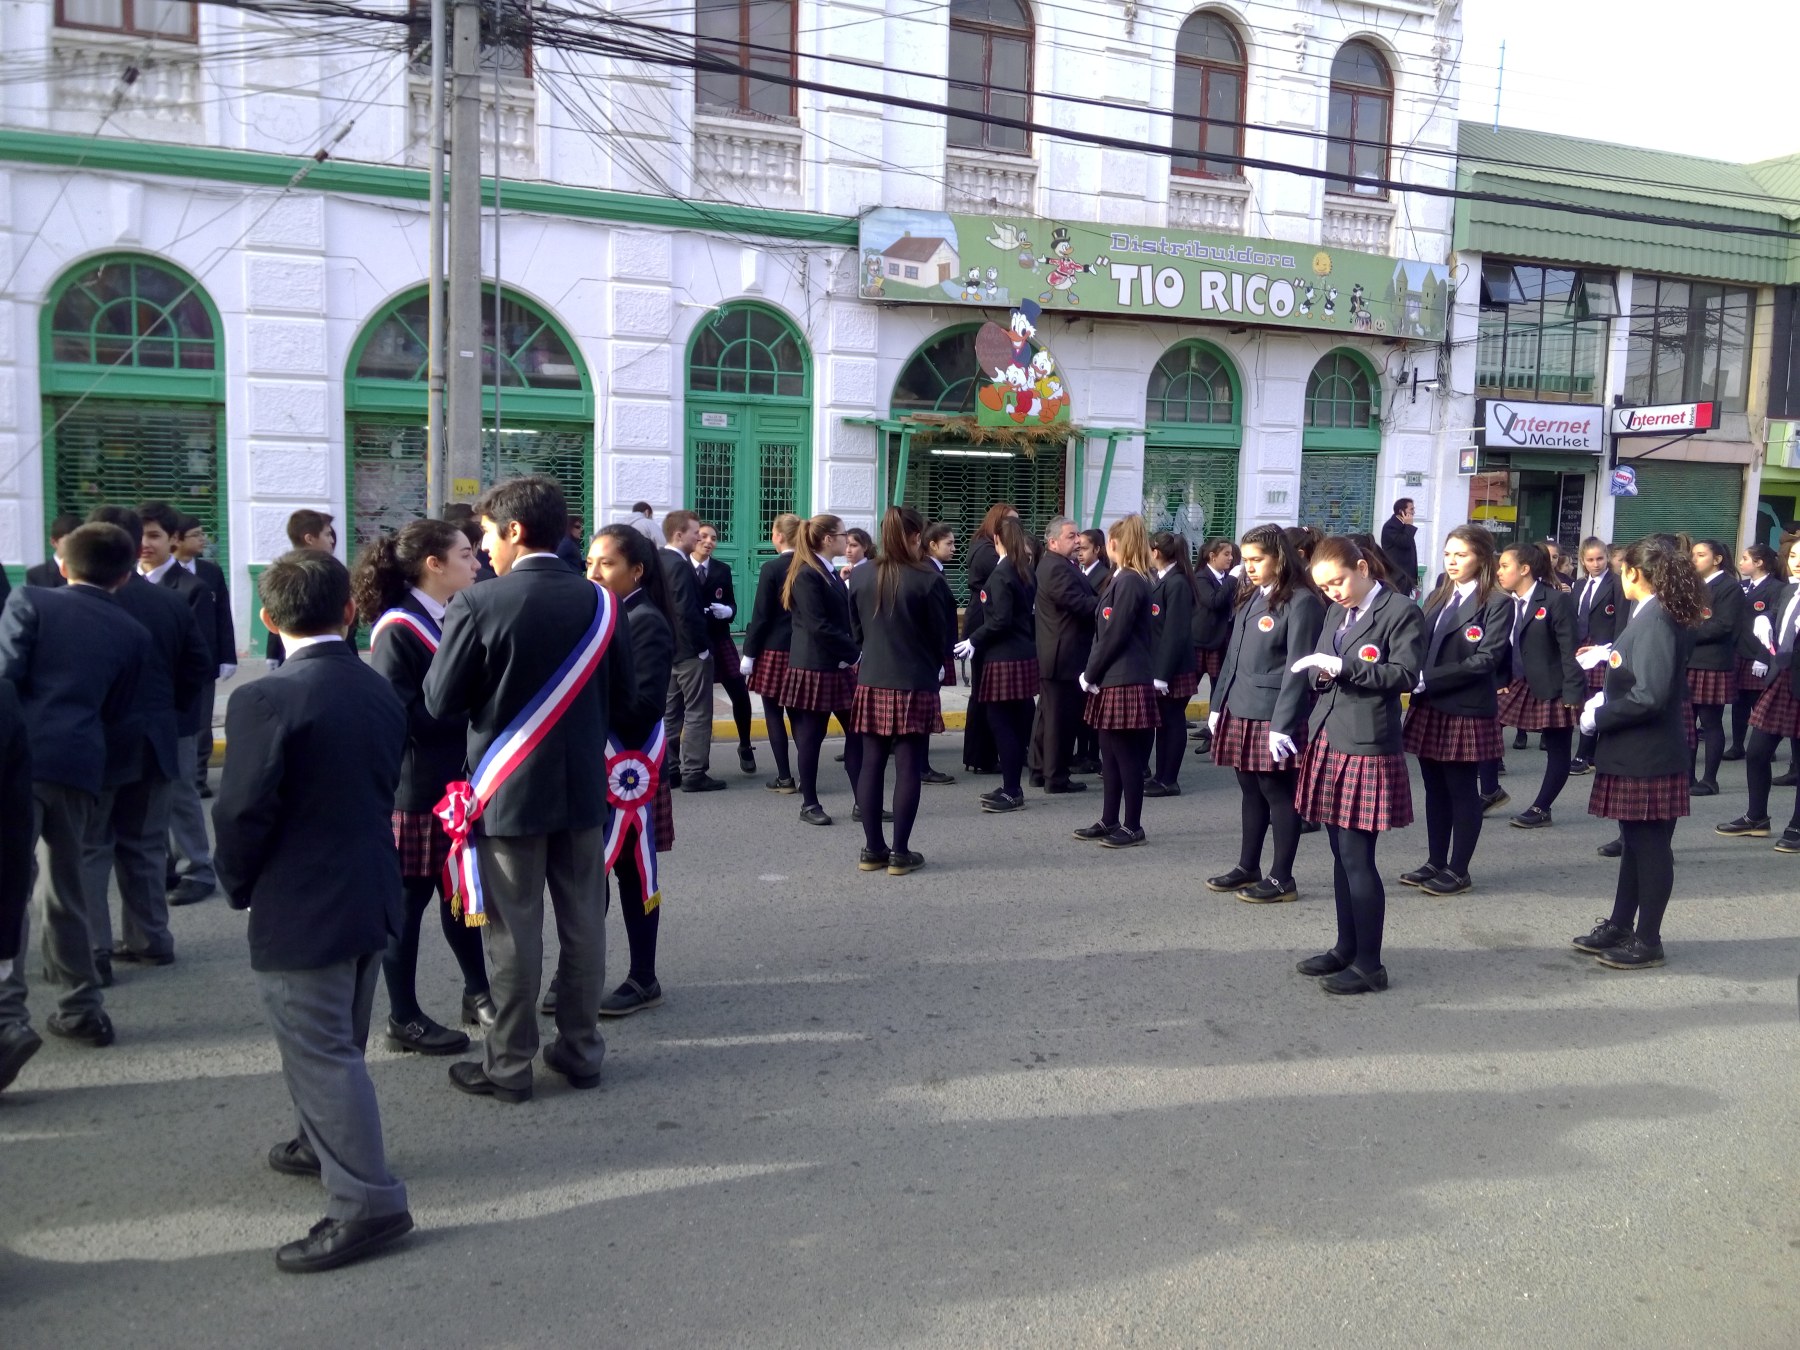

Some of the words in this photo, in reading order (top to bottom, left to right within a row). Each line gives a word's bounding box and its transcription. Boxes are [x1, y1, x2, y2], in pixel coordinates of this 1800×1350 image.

[1110, 232, 1295, 268] Distribuidora
[1502, 412, 1591, 435] Internet
[1626, 410, 1686, 430] Internet
[1529, 433, 1590, 448] Market
[1266, 490, 1288, 504] 1177
